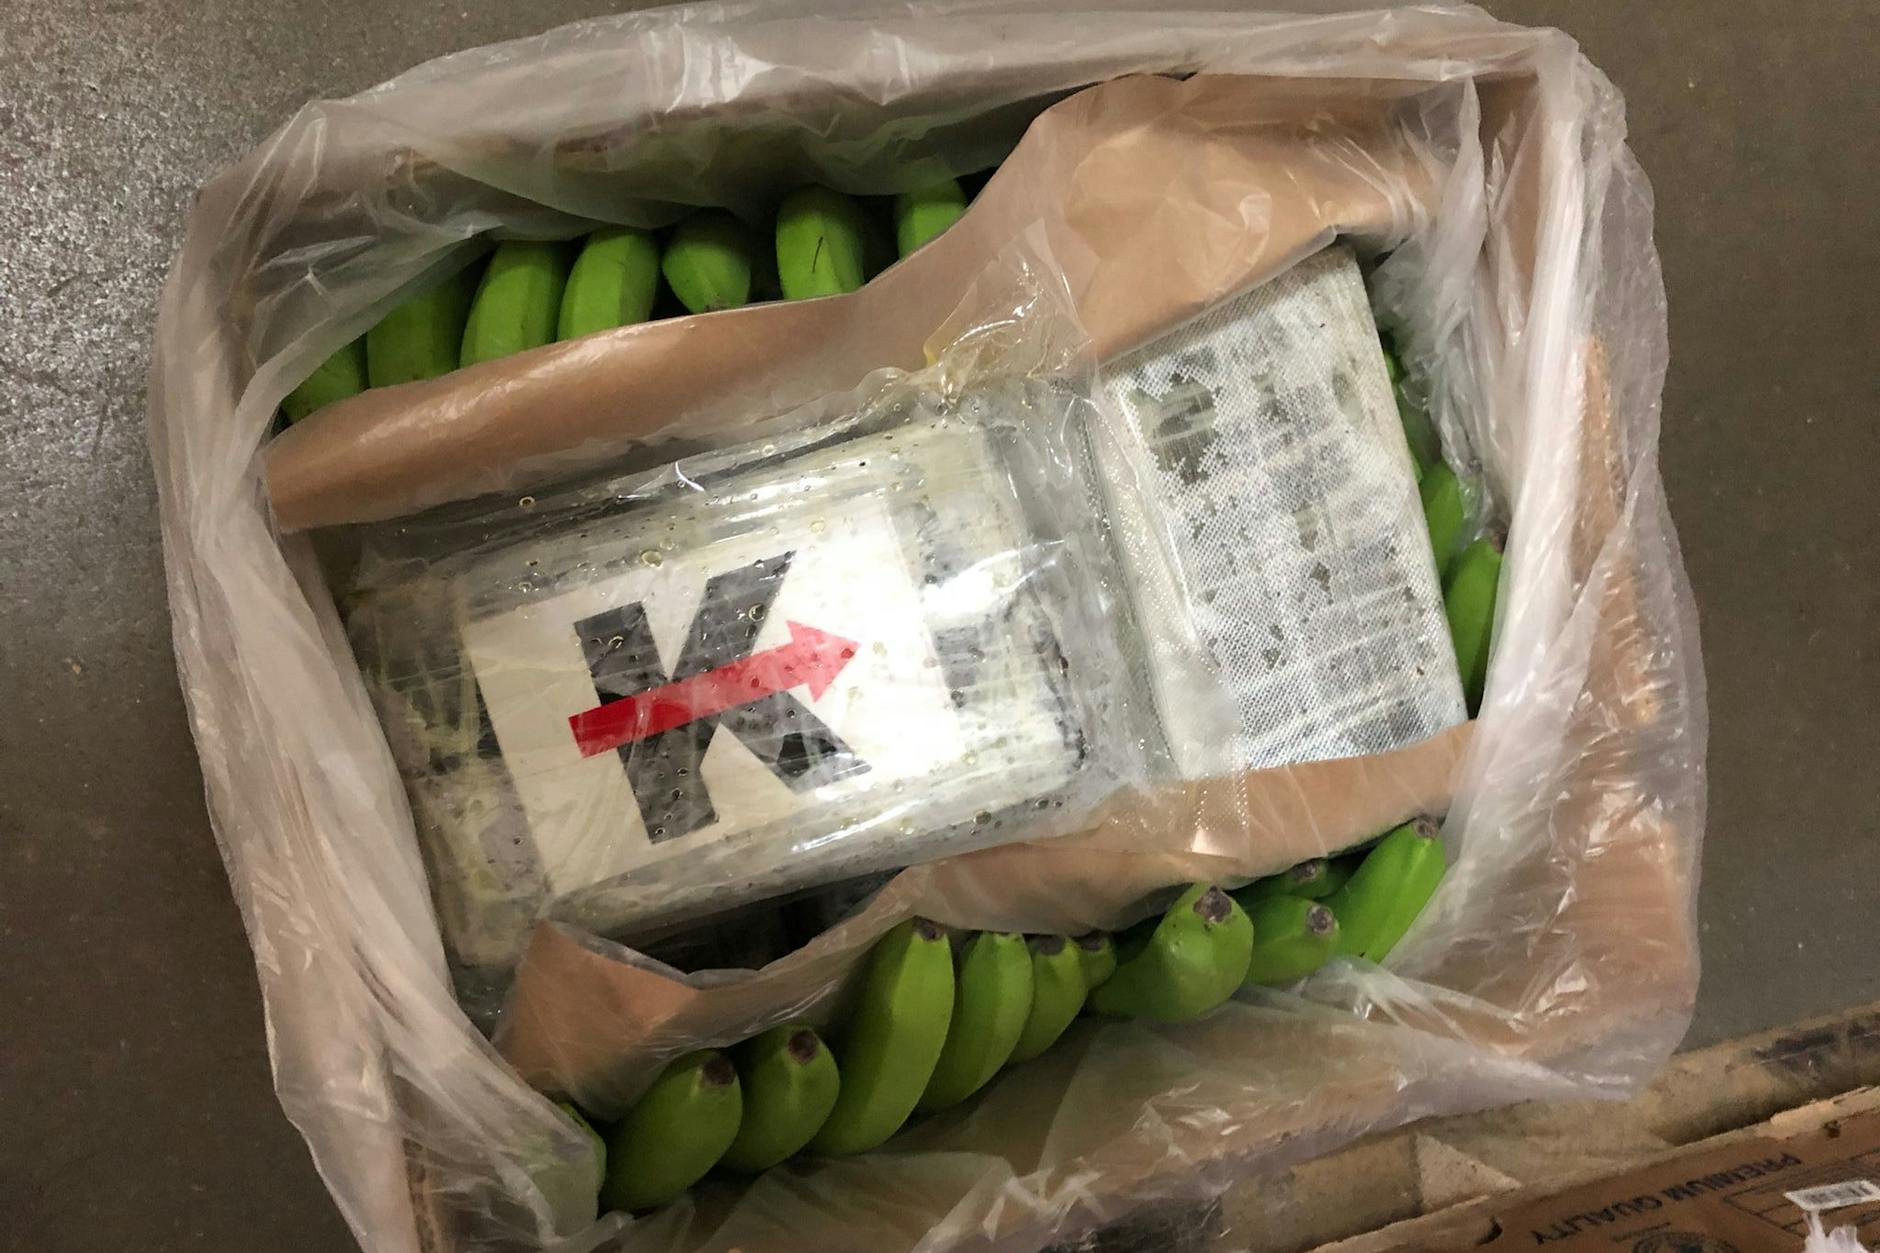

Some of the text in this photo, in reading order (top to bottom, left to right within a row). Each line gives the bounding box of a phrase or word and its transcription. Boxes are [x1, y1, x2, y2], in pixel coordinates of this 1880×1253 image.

[573, 550, 872, 845] K
[1662, 1152, 1802, 1201] PREMIUM
[1531, 1195, 1662, 1245] QUALITY
